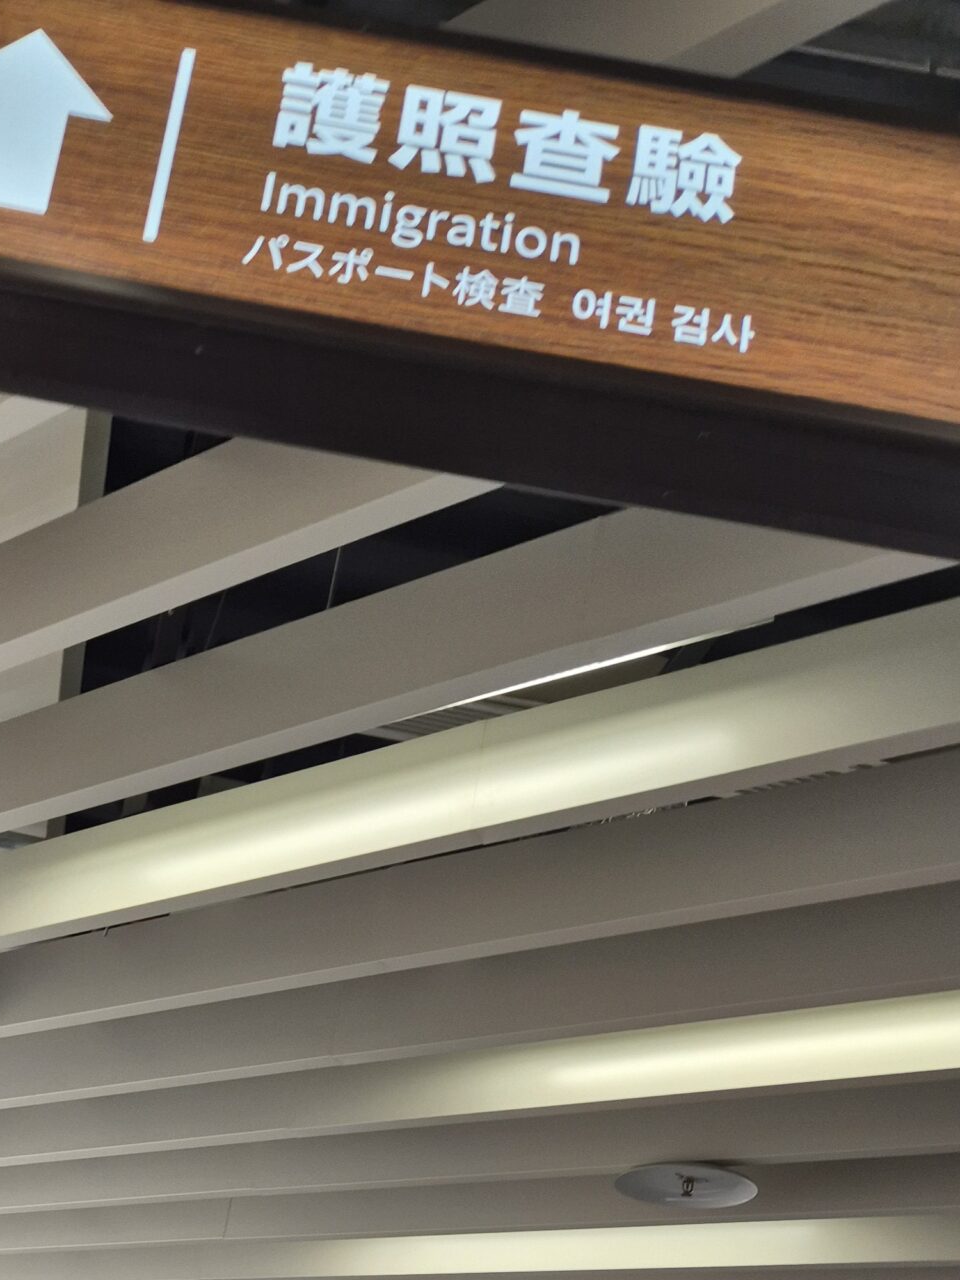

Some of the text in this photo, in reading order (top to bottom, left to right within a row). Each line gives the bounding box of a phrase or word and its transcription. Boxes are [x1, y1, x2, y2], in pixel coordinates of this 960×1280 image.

[272, 61, 742, 224] 護照查驗
[260, 171, 581, 266] Immigration
[242, 233, 545, 318] パスポート検査
[572, 288, 755, 353] 여권 검사
